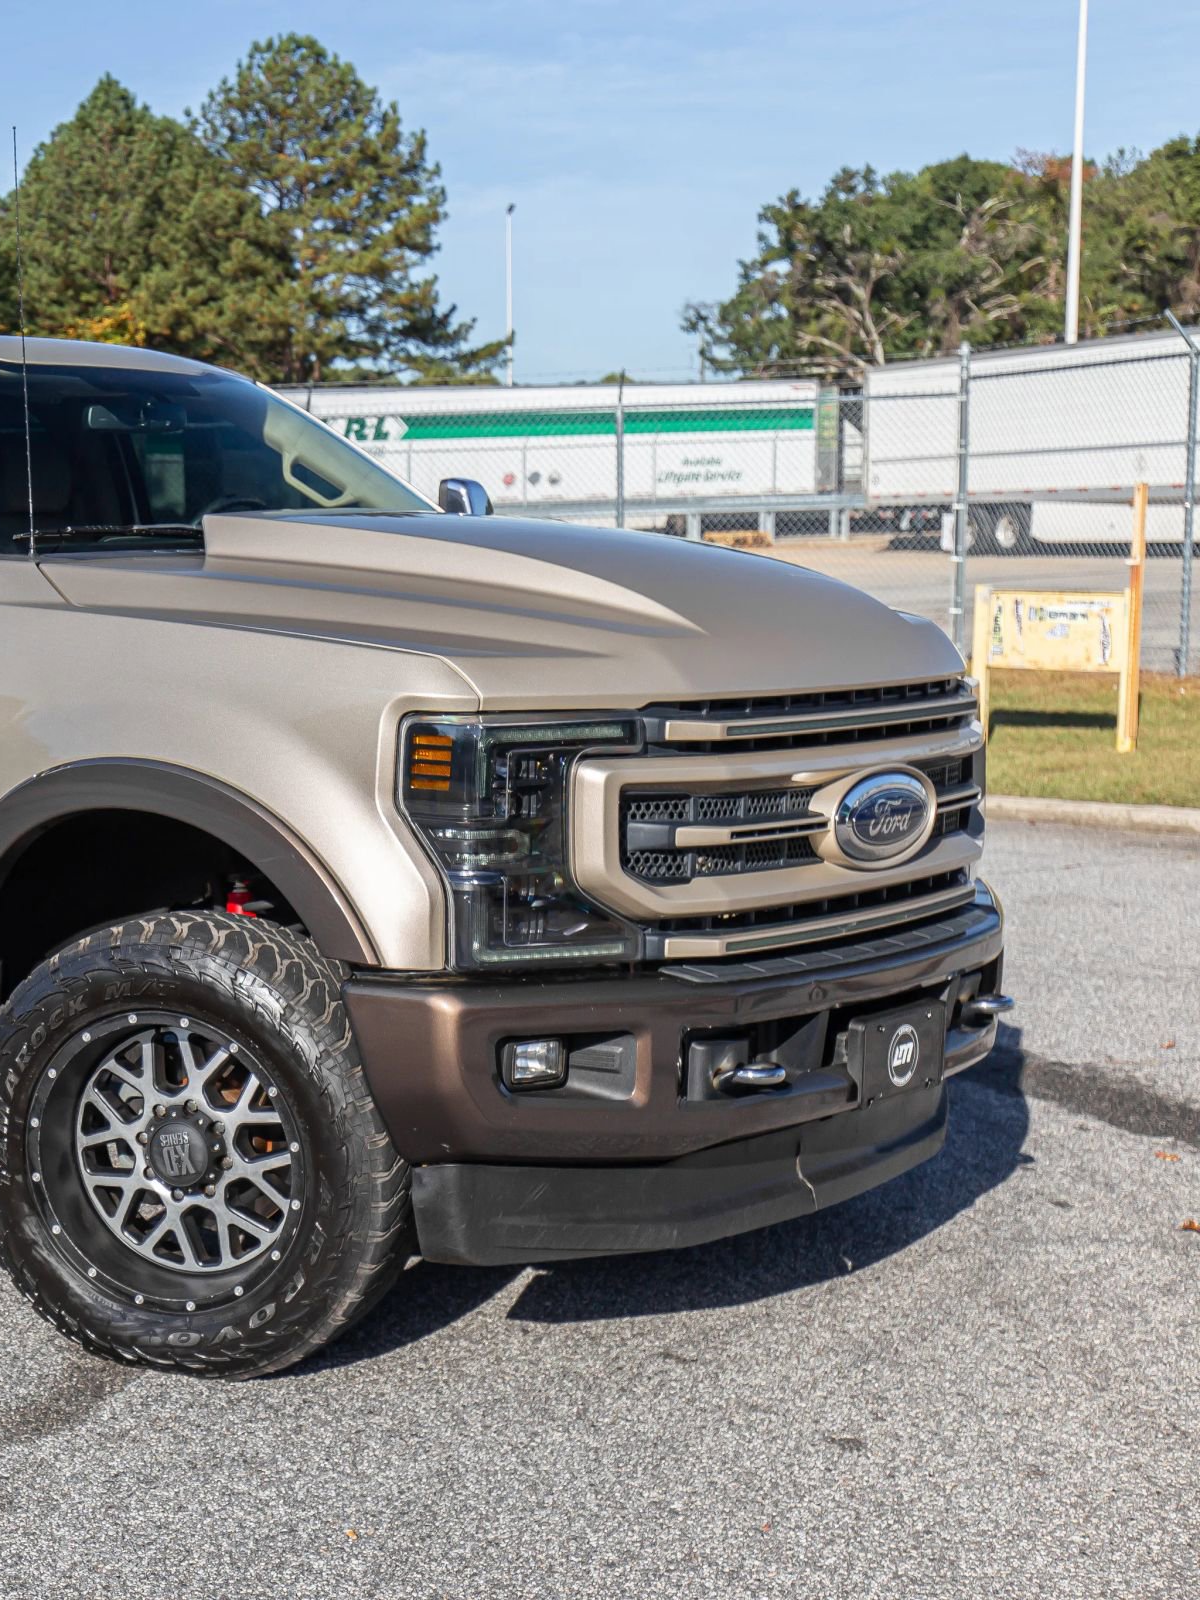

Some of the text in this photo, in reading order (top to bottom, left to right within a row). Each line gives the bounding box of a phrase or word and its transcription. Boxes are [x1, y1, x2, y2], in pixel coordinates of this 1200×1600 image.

[703, 469, 743, 481] Service
[869, 798, 912, 837] Ford
[159, 1131, 190, 1147] SERIES
